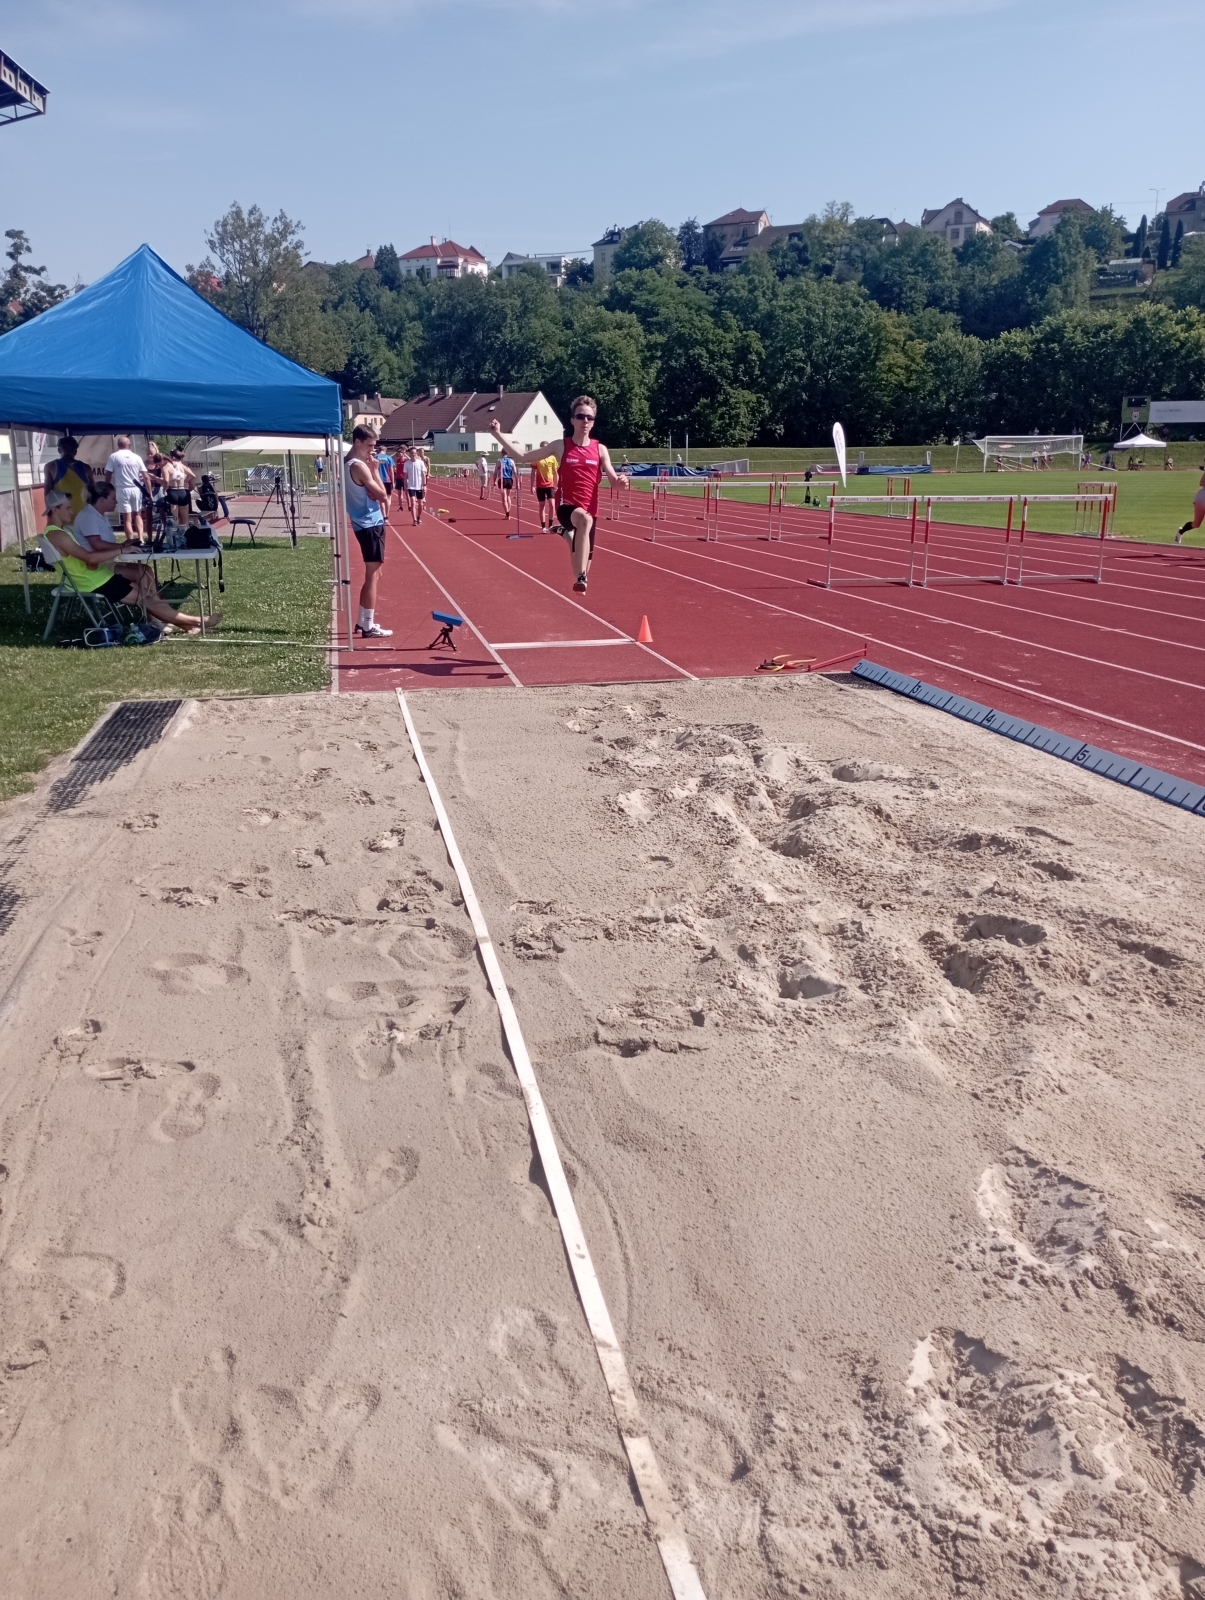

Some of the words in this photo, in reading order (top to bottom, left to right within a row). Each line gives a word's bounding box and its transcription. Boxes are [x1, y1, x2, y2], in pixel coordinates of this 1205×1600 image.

[853, 662, 862, 670] 2
[912, 685, 921, 694] 3
[985, 714, 995, 723] 4
[1076, 749, 1089, 761] 5
